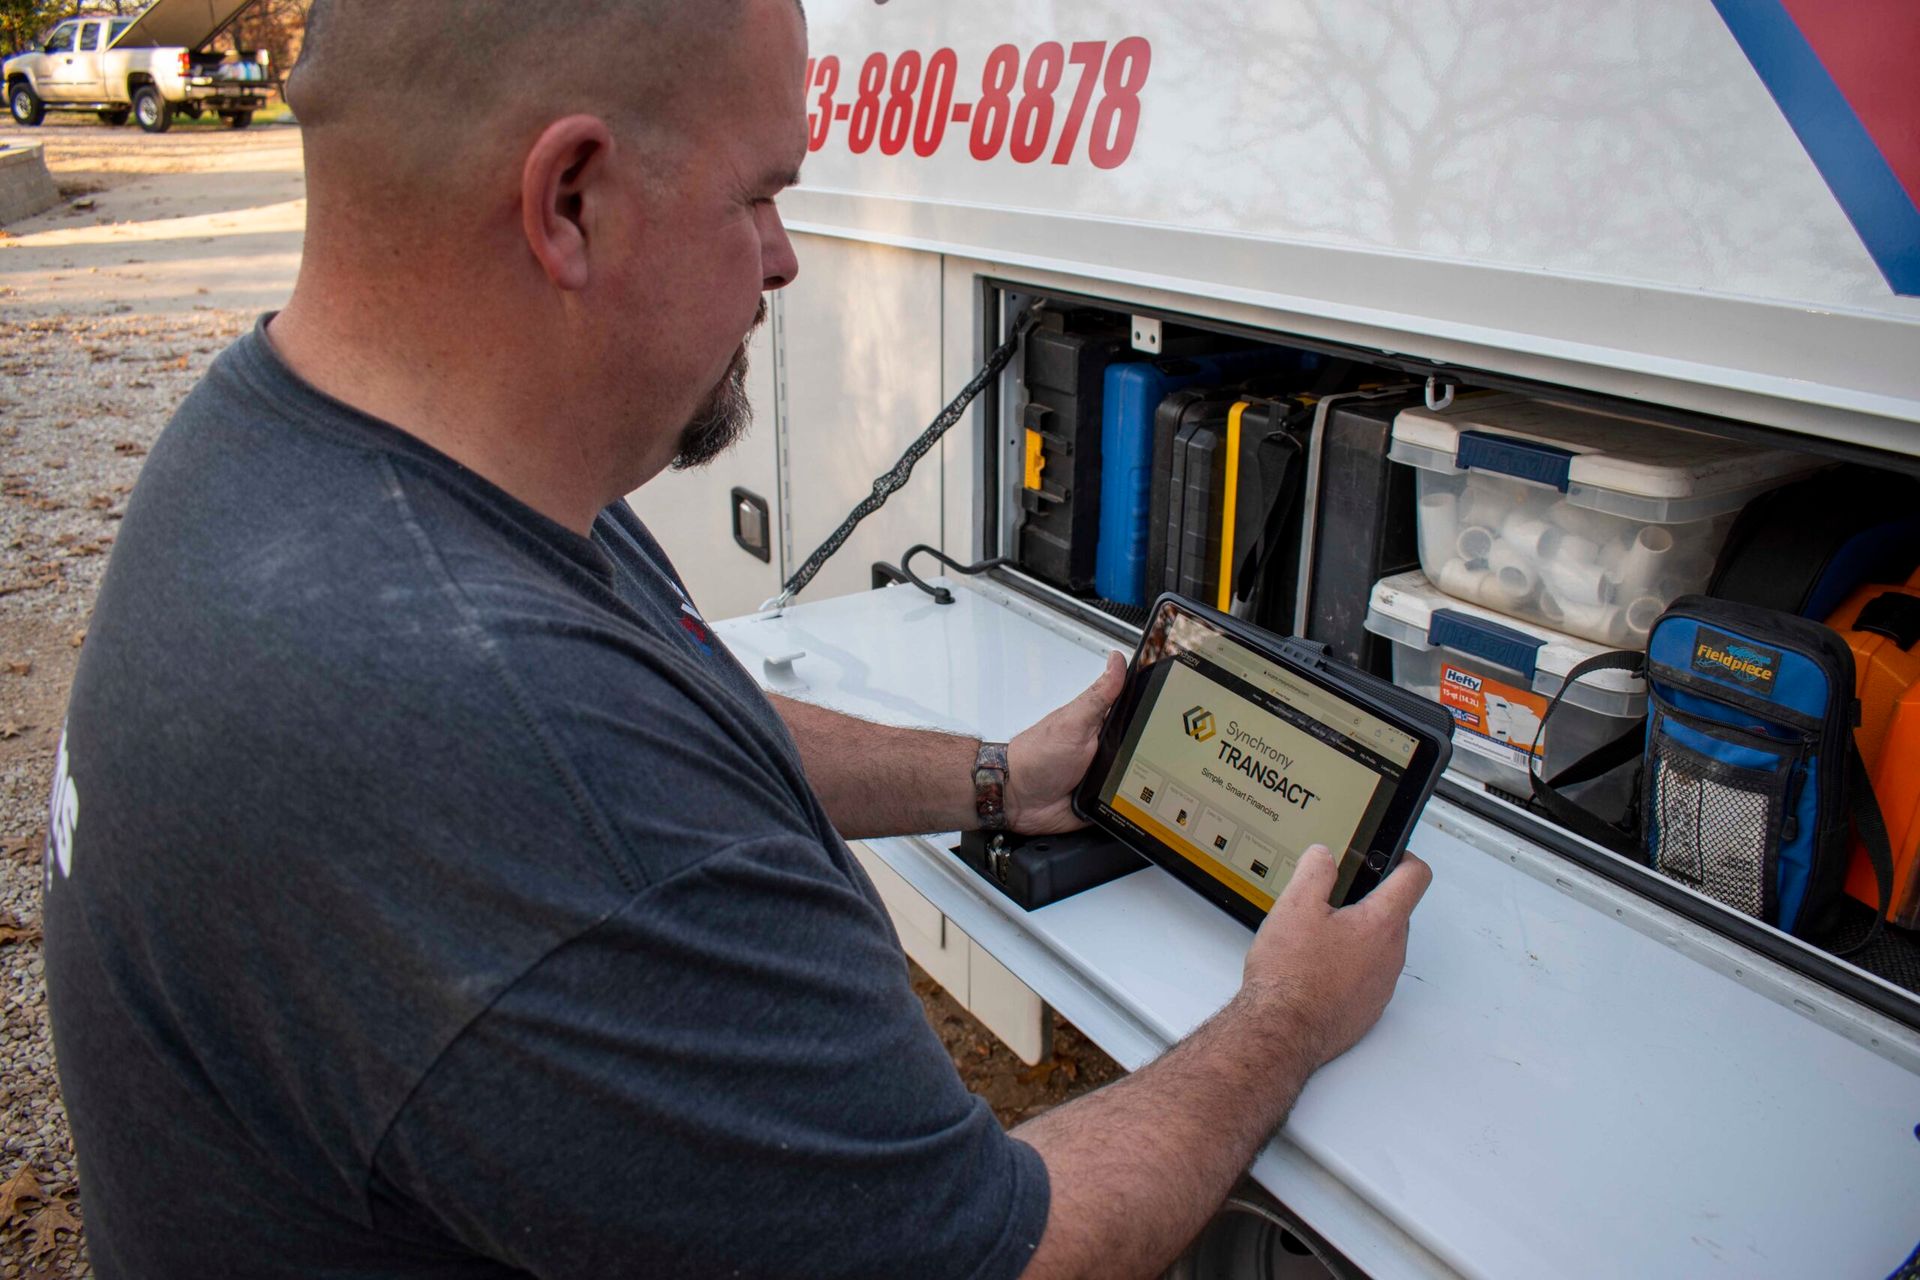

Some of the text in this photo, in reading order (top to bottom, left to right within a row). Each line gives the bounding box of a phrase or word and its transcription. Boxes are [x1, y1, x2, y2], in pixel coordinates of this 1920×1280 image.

[1447, 670, 1480, 691] Hefty
[1697, 643, 1773, 681] Fieldpiece
[1226, 720, 1294, 770] Synchrony
[1201, 767, 1224, 788] Simple,
[1226, 782, 1247, 801] Smart
[1246, 794, 1280, 823] Financing.
